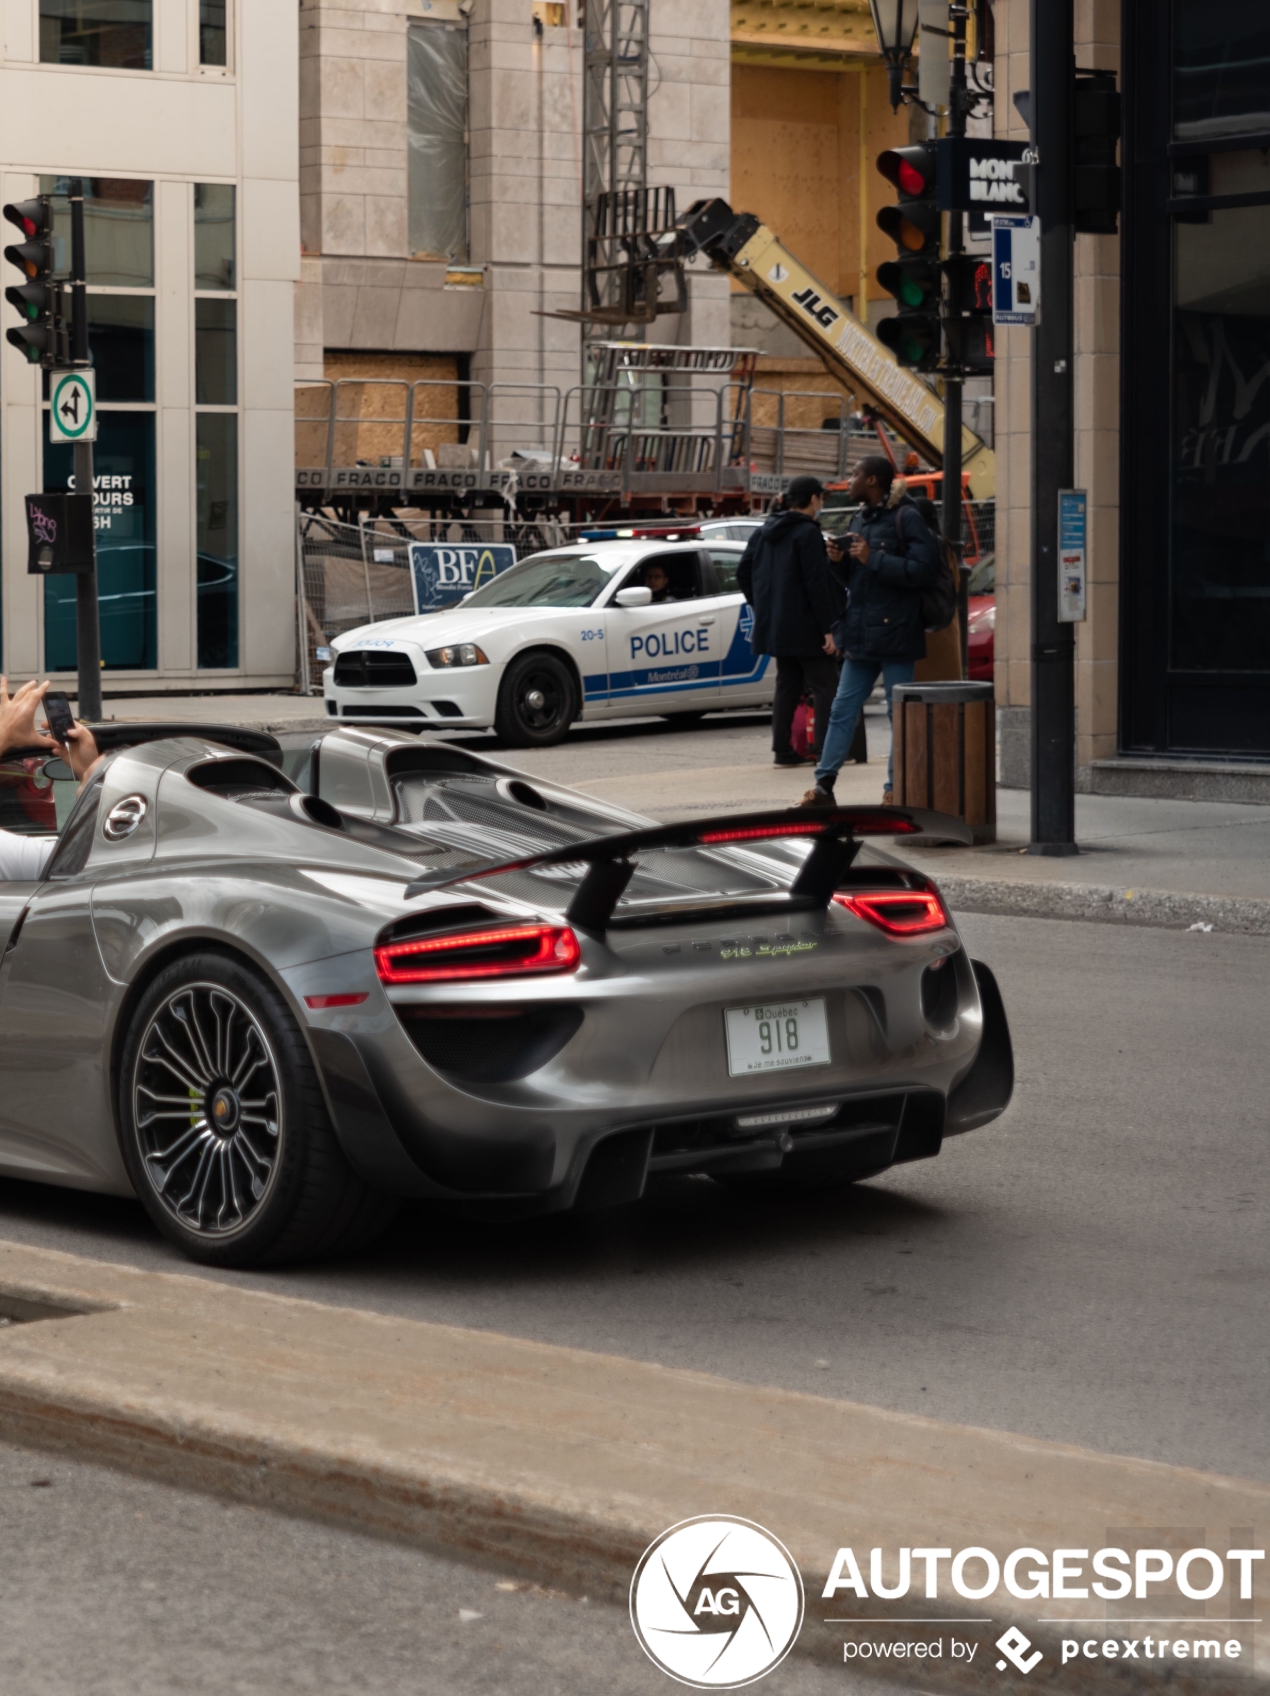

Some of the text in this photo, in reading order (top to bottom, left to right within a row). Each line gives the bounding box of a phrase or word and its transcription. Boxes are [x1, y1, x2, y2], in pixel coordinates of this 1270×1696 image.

[969, 180, 1025, 203] BLANC
[999, 262, 1012, 279] 15
[791, 287, 839, 330] JLG
[337, 472, 401, 486] FRACO
[414, 473, 476, 487] FRACO
[433, 549, 497, 592] BFA
[581, 629, 605, 641] 20-5
[630, 629, 709, 659] POLICE
[647, 668, 688, 683] Montréal
[764, 1007, 799, 1020] Québec
[758, 1018, 799, 1054] 918
[753, 1055, 808, 1069] Je me souviens
